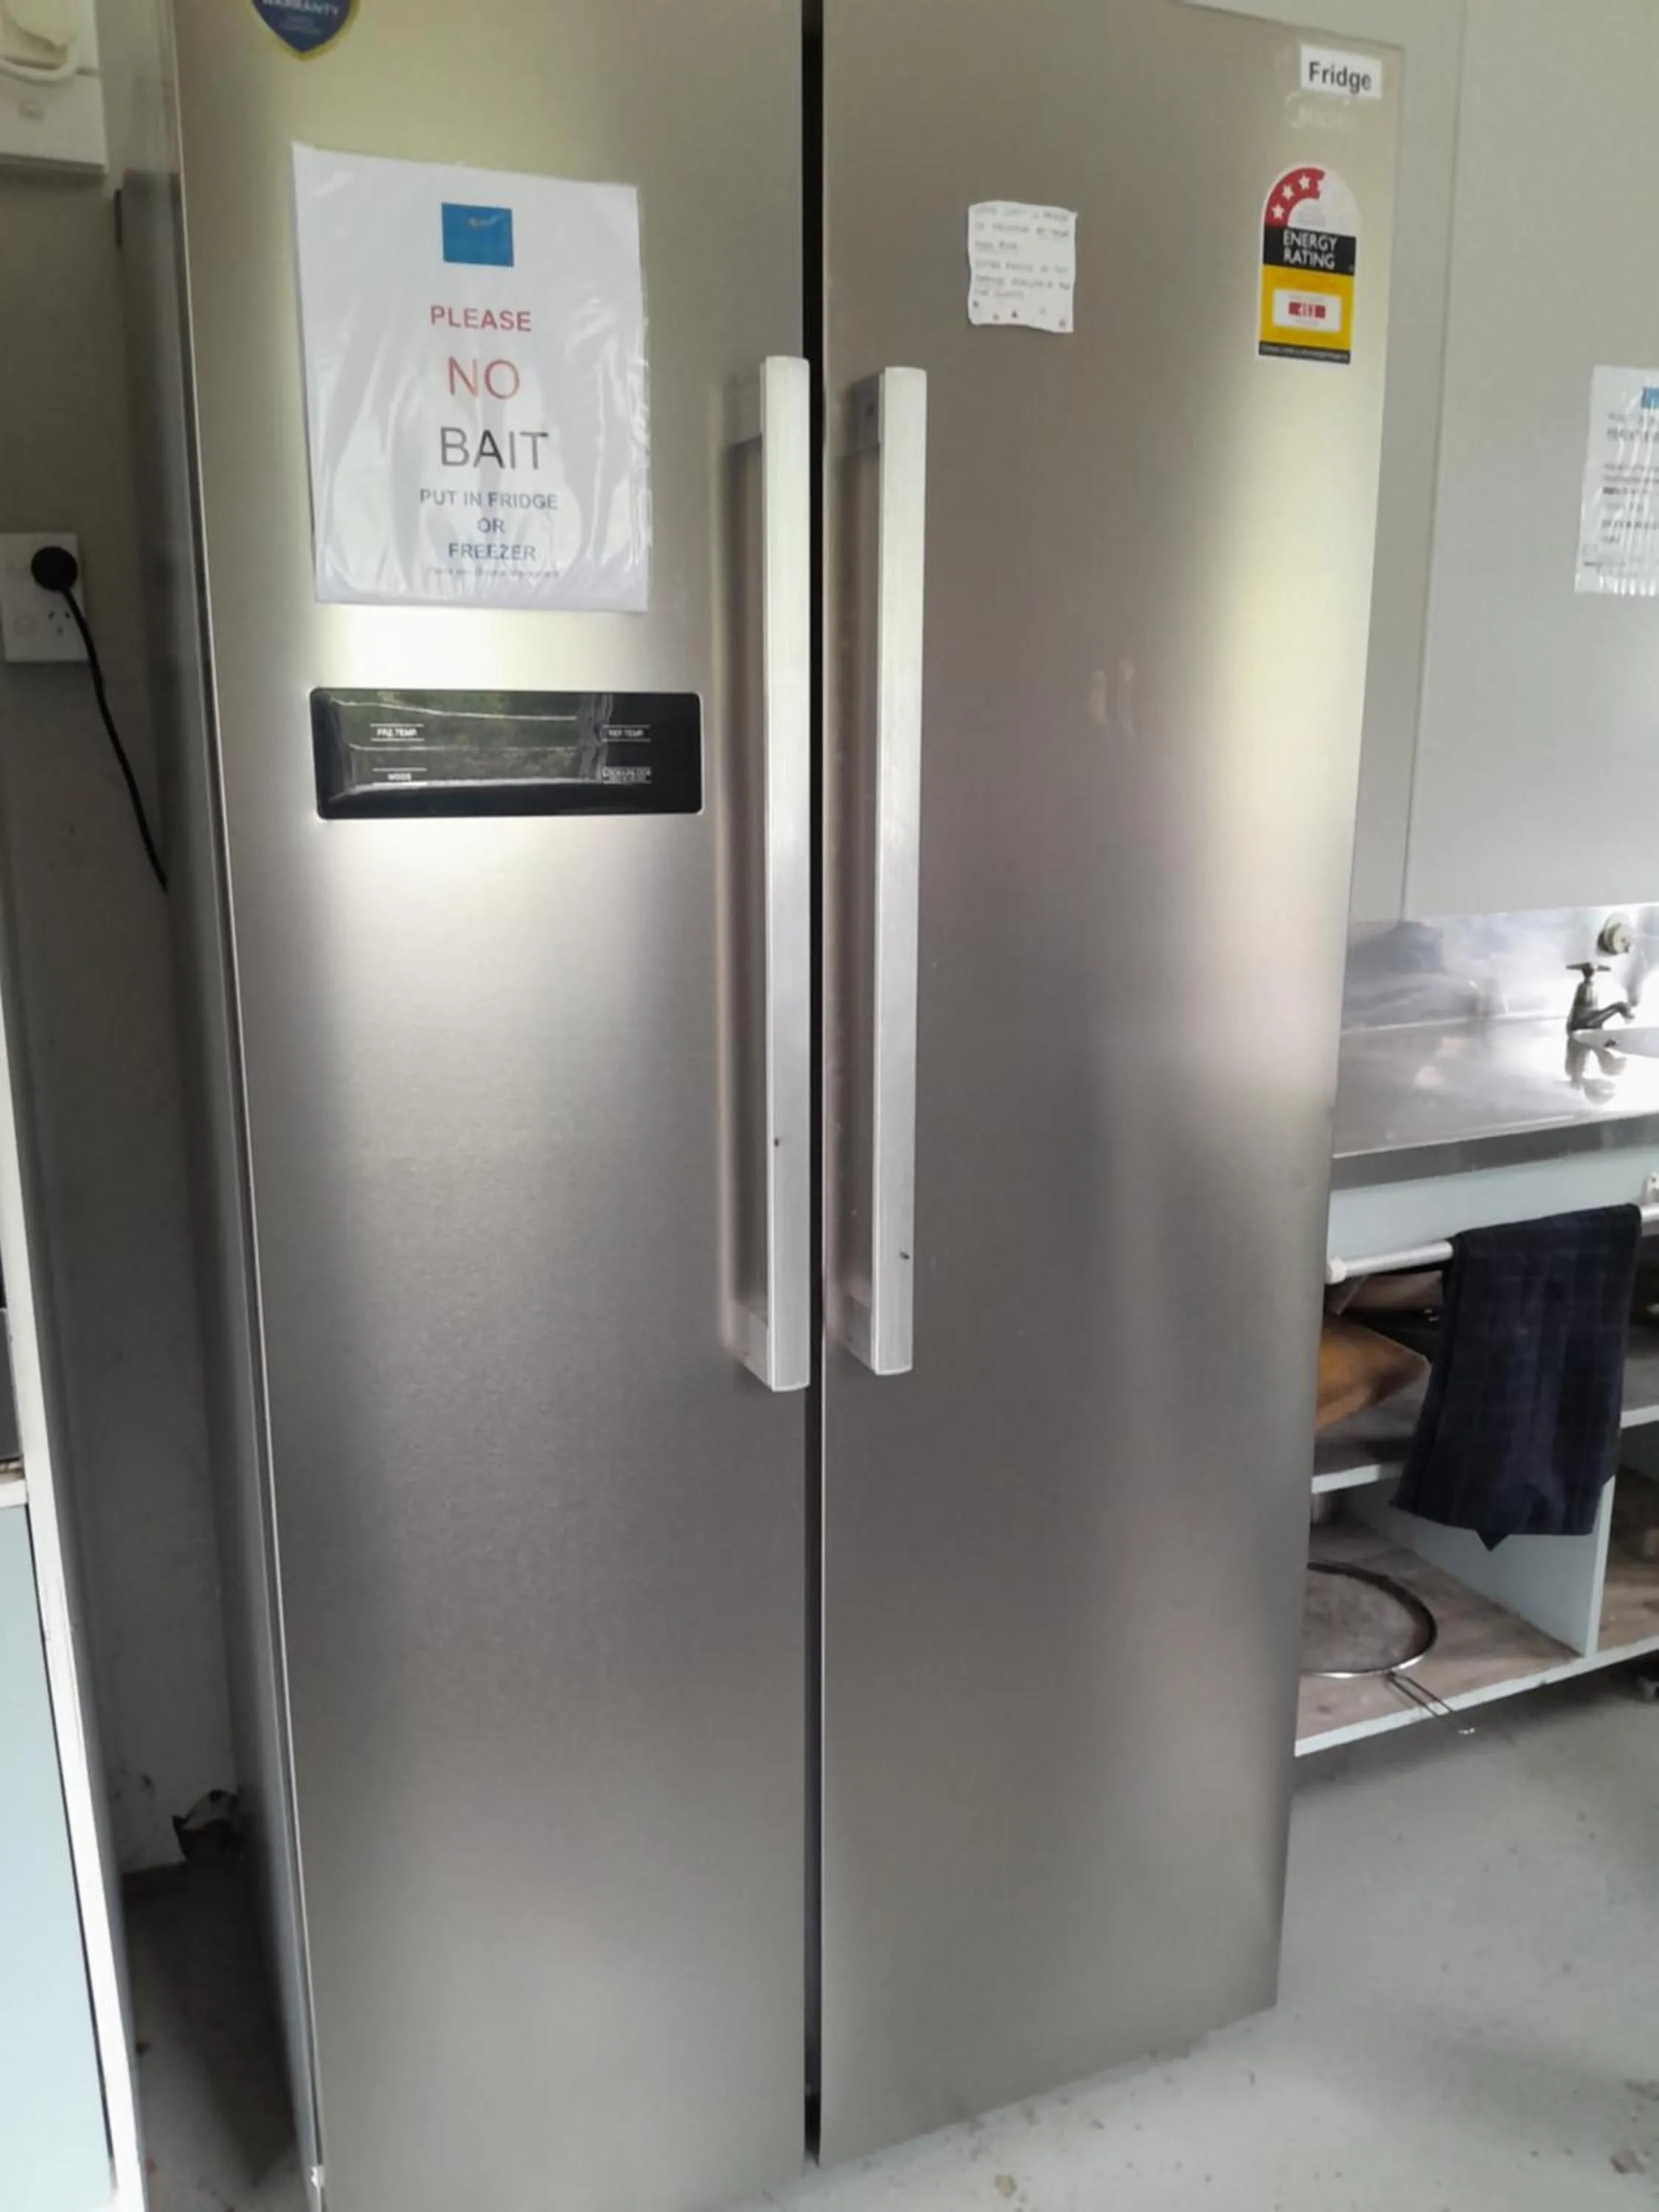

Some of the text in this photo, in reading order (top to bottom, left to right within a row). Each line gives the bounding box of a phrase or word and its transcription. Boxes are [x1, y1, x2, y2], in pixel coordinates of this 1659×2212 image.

[1309, 60, 1371, 94] Fridge
[1284, 229, 1338, 251] ENERGY
[1283, 246, 1336, 270] RATING
[430, 305, 532, 332] PLEASE
[448, 355, 520, 400] NO
[440, 425, 549, 470] BAIT
[419, 488, 558, 510] PUT IN FRIDGE
[477, 517, 505, 533] OR
[448, 542, 537, 561] FREEZER
